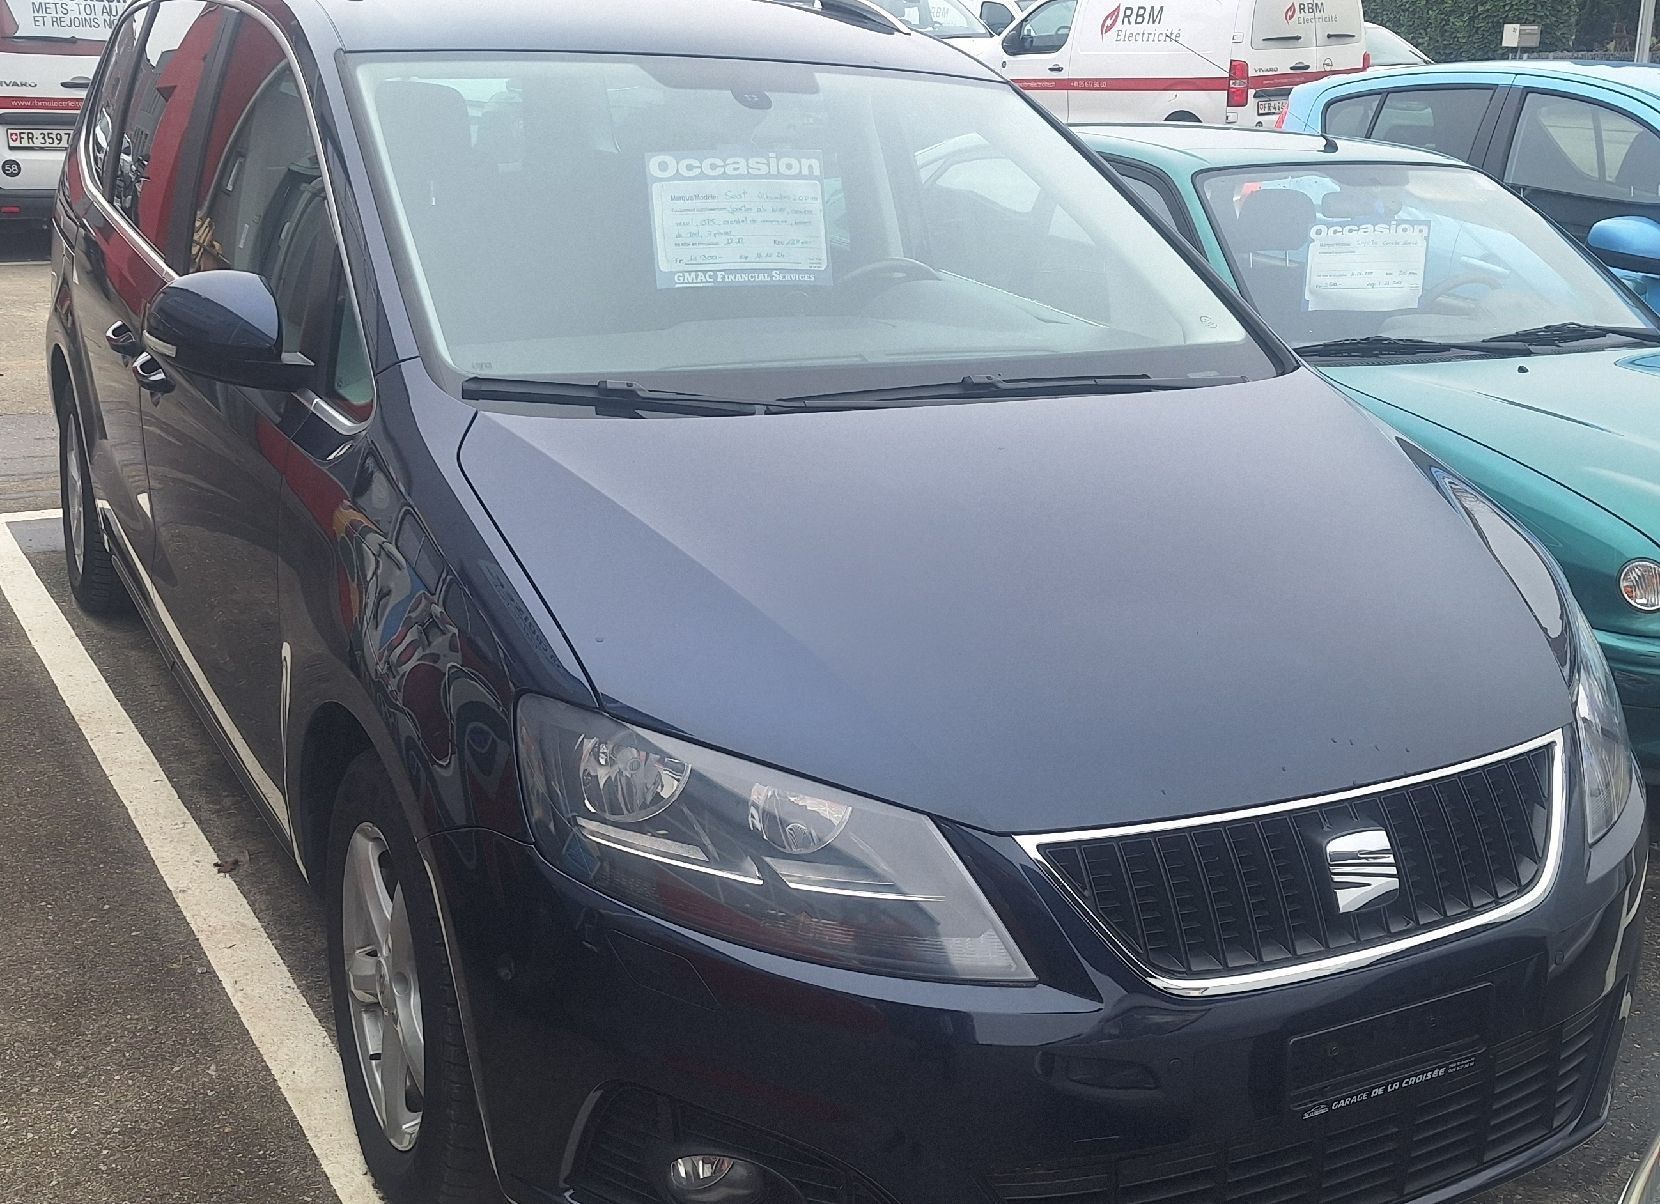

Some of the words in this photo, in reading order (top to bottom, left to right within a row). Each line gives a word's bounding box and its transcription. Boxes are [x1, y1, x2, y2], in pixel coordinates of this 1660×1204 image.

[32, 2, 96, 15] METS-TOI
[1121, 5, 1164, 25] RBM
[1298, 2, 1326, 14] RBM
[33, 16, 48, 27] ET
[51, 17, 100, 29] REJOINS
[1114, 27, 1182, 42] Electricité
[5, 164, 19, 174] 58
[649, 152, 822, 178] Occasion
[1309, 221, 1430, 237] Occasion
[674, 272, 714, 284] GMAC
[717, 271, 770, 282] FINANCIAL
[772, 270, 816, 282] SERVICES
[1332, 1091, 1370, 1110] GARAGE
[1370, 1086, 1386, 1098] DE
[1387, 1081, 1400, 1093] LA
